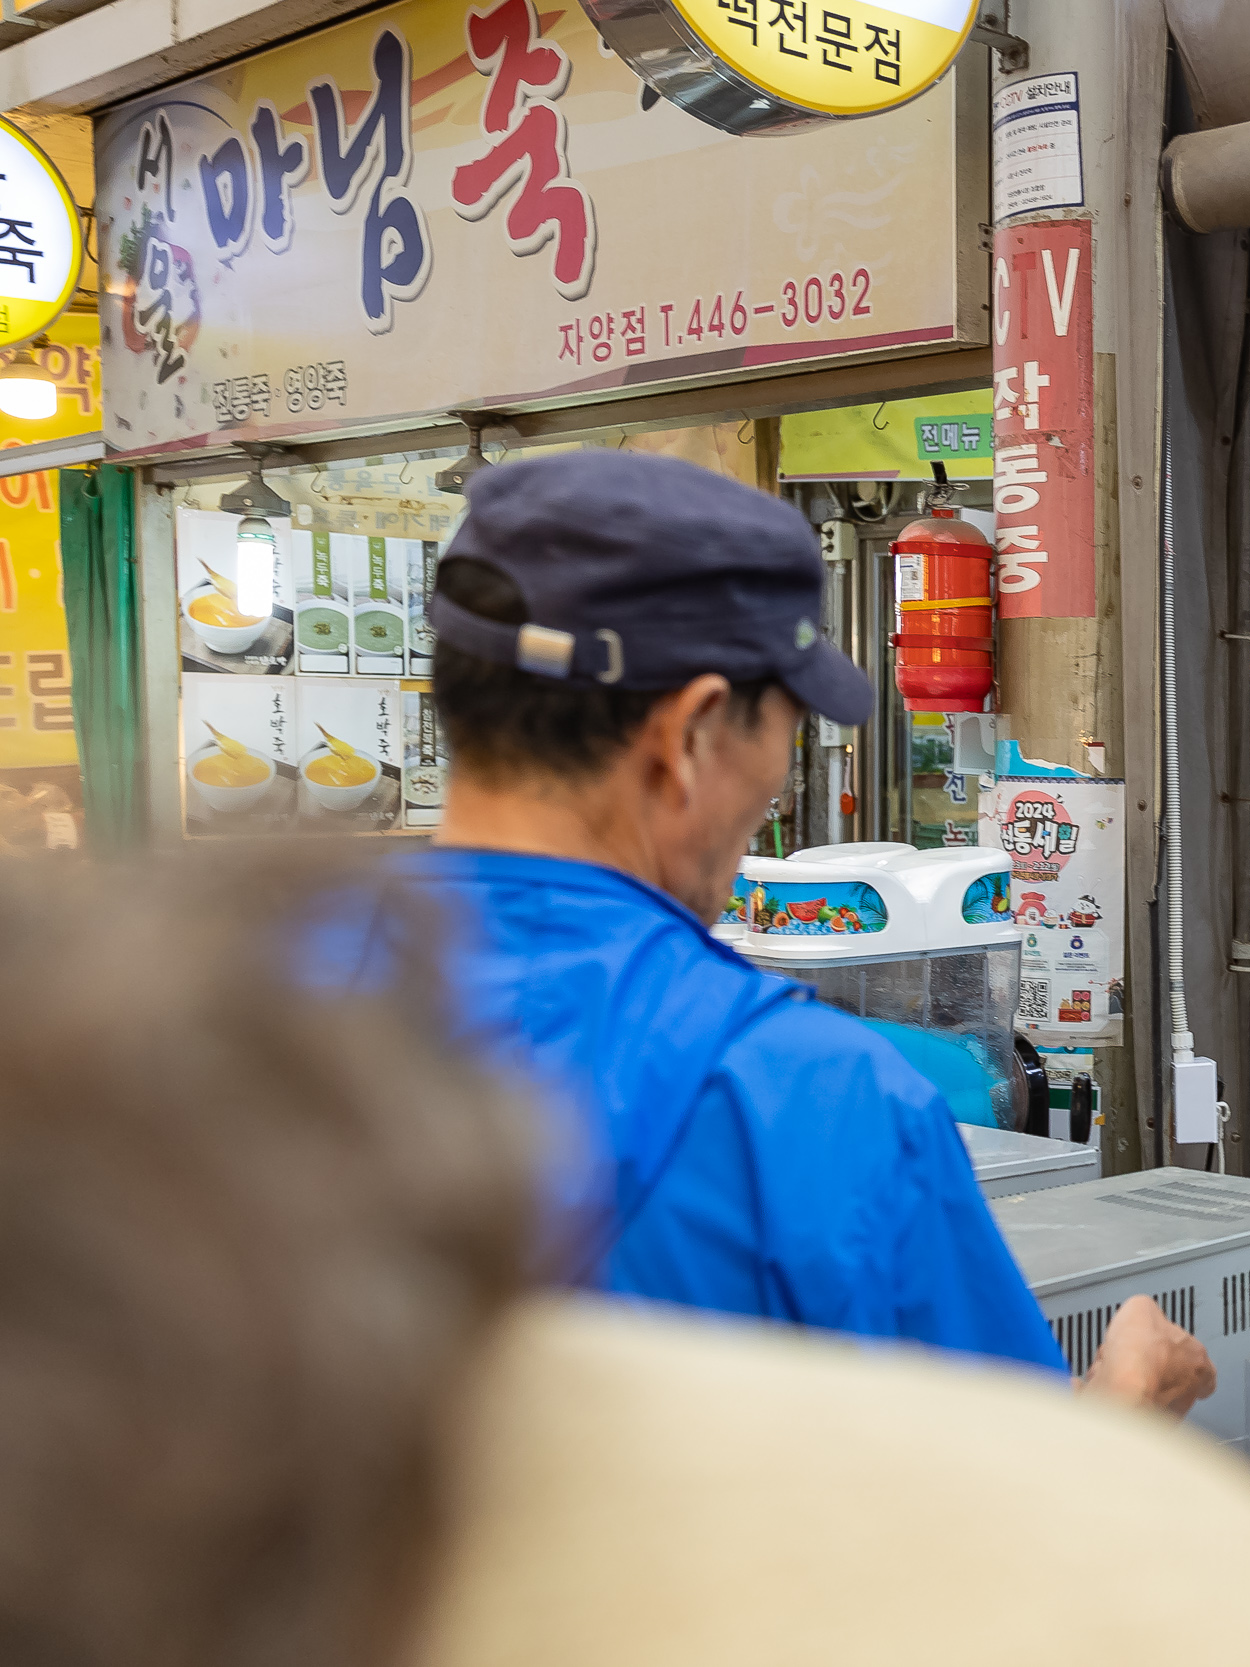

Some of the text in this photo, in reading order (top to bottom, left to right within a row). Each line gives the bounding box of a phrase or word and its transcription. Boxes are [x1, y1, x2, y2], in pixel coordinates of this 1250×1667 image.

[557, 304, 648, 366] 자양점
[212, 359, 348, 424] 전통죽 영양죽
[1015, 801, 1056, 820] 2024
